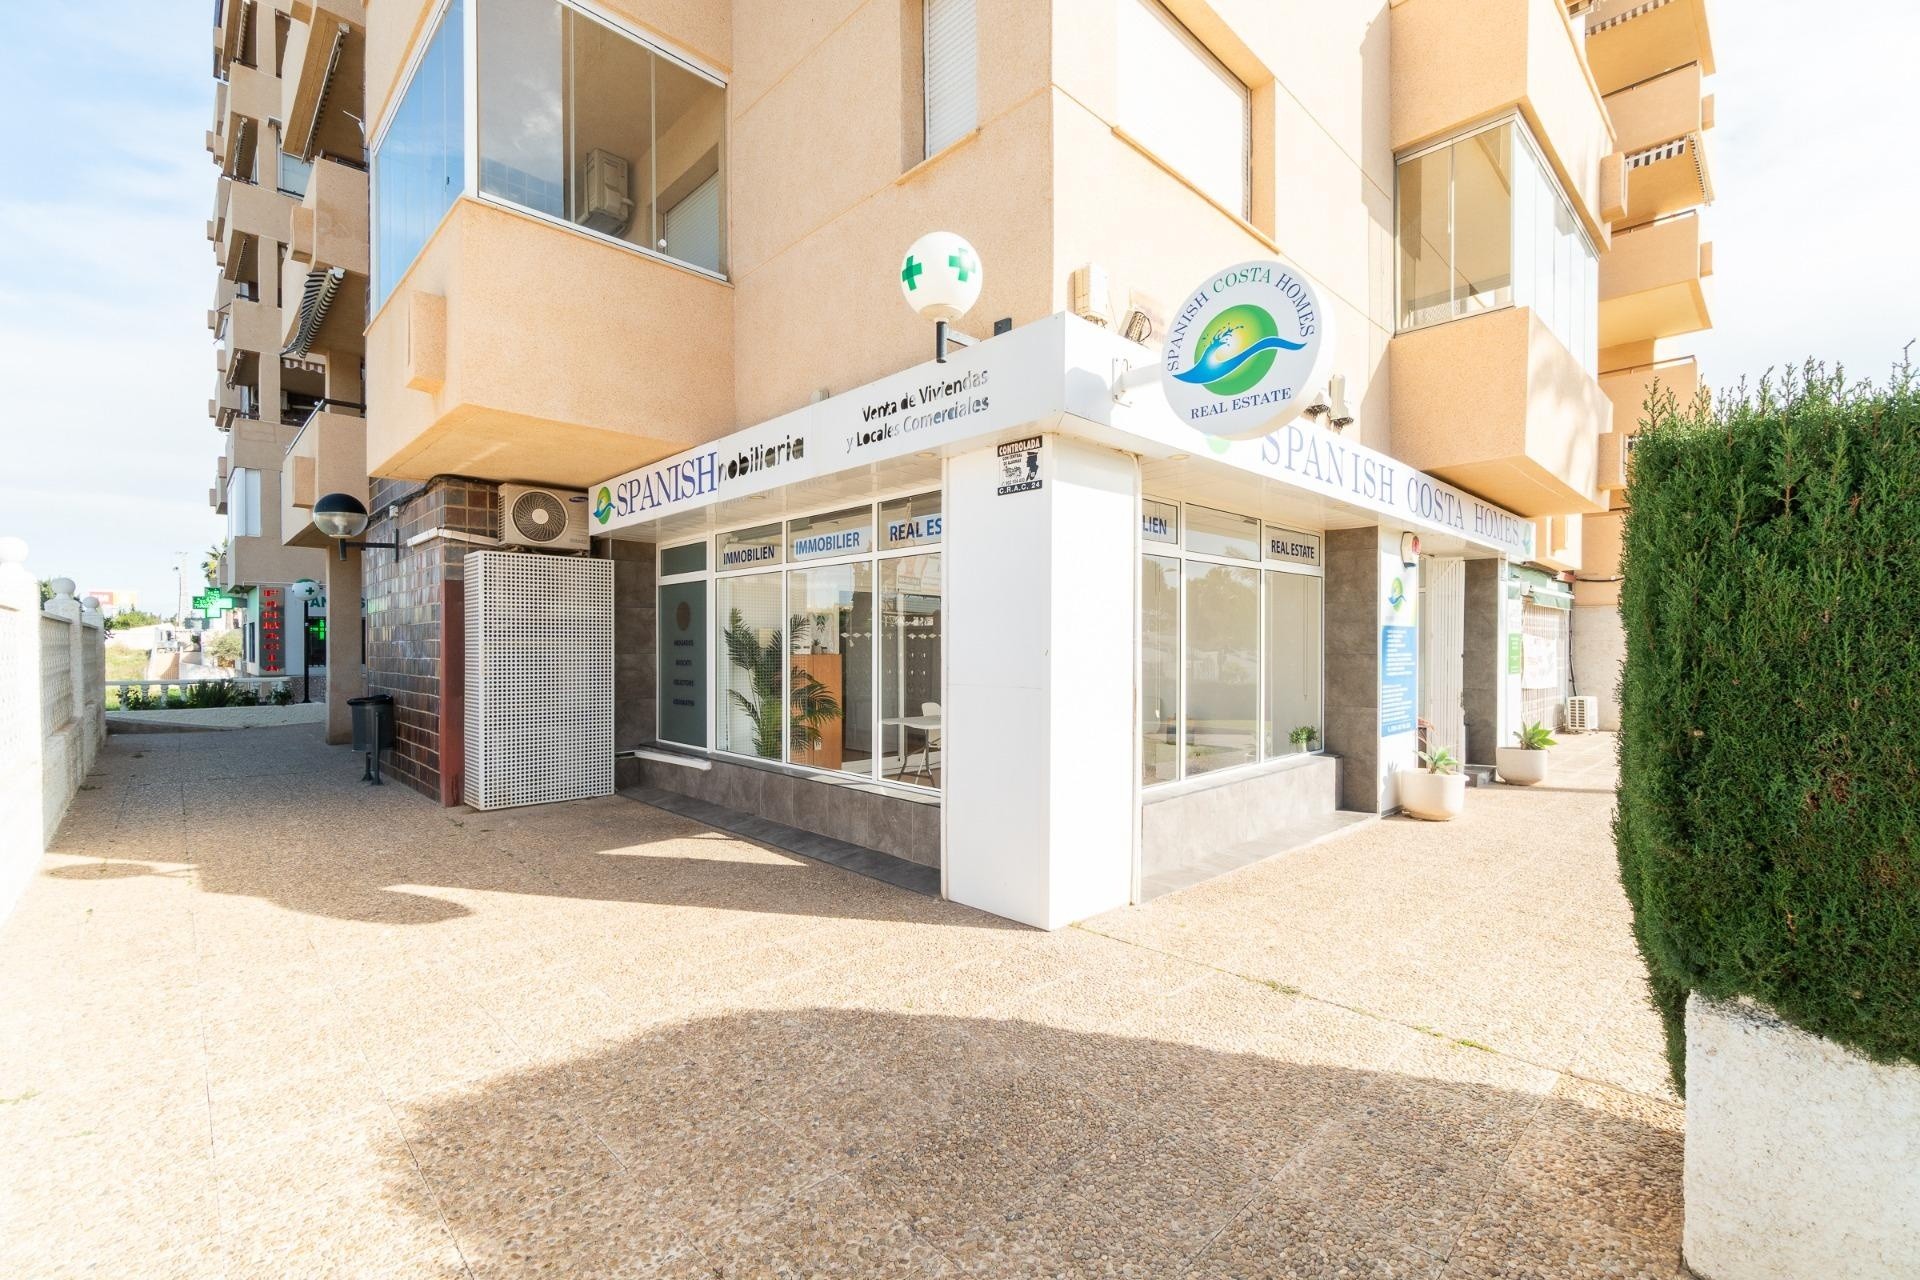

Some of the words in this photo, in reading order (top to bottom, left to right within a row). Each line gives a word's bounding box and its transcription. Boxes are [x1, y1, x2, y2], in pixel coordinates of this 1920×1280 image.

[1167, 291, 1209, 372] SPANISH
[1213, 267, 1272, 293] COSTA
[1275, 273, 1315, 337] HOMES
[862, 400, 897, 422] Venta
[900, 392, 916, 410] de
[919, 369, 989, 404] Viviendas
[1191, 402, 1228, 420] REAL
[1232, 387, 1292, 411] ESTATE
[846, 437, 854, 454] y
[857, 423, 900, 447] Locales
[903, 395, 989, 433] Comerciales
[999, 438, 1040, 456] CONTROLADA
[616, 452, 718, 518] SPANISH
[999, 483, 1029, 495] C.R.A.C.
[1031, 481, 1040, 489] 24
[1261, 425, 1395, 506] SPANISH
[1407, 476, 1465, 530] COSTA
[1473, 502, 1519, 547] HOMES
[795, 531, 860, 556] IMMOBILIER
[890, 522, 923, 542] REAL
[723, 545, 775, 566] IMMOBILIEN
[1271, 539, 1290, 555] REAL
[1291, 544, 1315, 559] ESTATE
